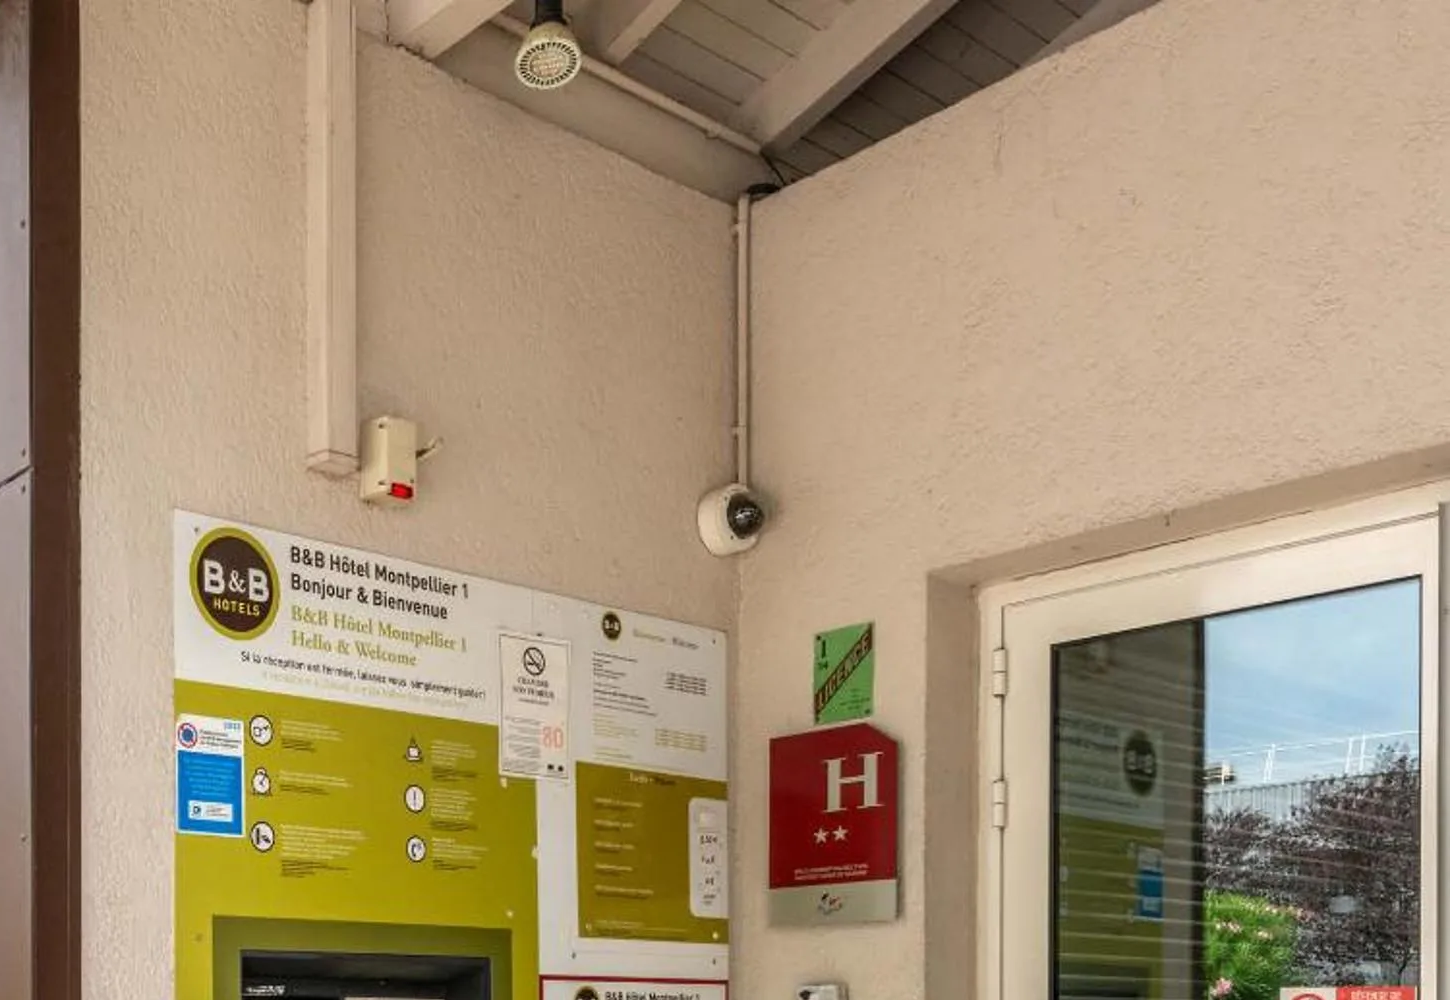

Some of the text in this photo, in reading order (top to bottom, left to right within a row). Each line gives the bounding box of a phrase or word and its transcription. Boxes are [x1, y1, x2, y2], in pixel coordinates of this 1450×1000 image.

[203, 559, 270, 602] B&B
[290, 546, 469, 599] B&B Hôtel Montpellier 1
[213, 598, 260, 617] HOTELS
[291, 573, 448, 619] Bonjour & Bienvenue
[291, 605, 467, 652] B&B Hôtel Montpellier 1
[291, 630, 417, 666] Hello & Welcome
[817, 632, 871, 708] LICENCE
[822, 751, 886, 813] H
